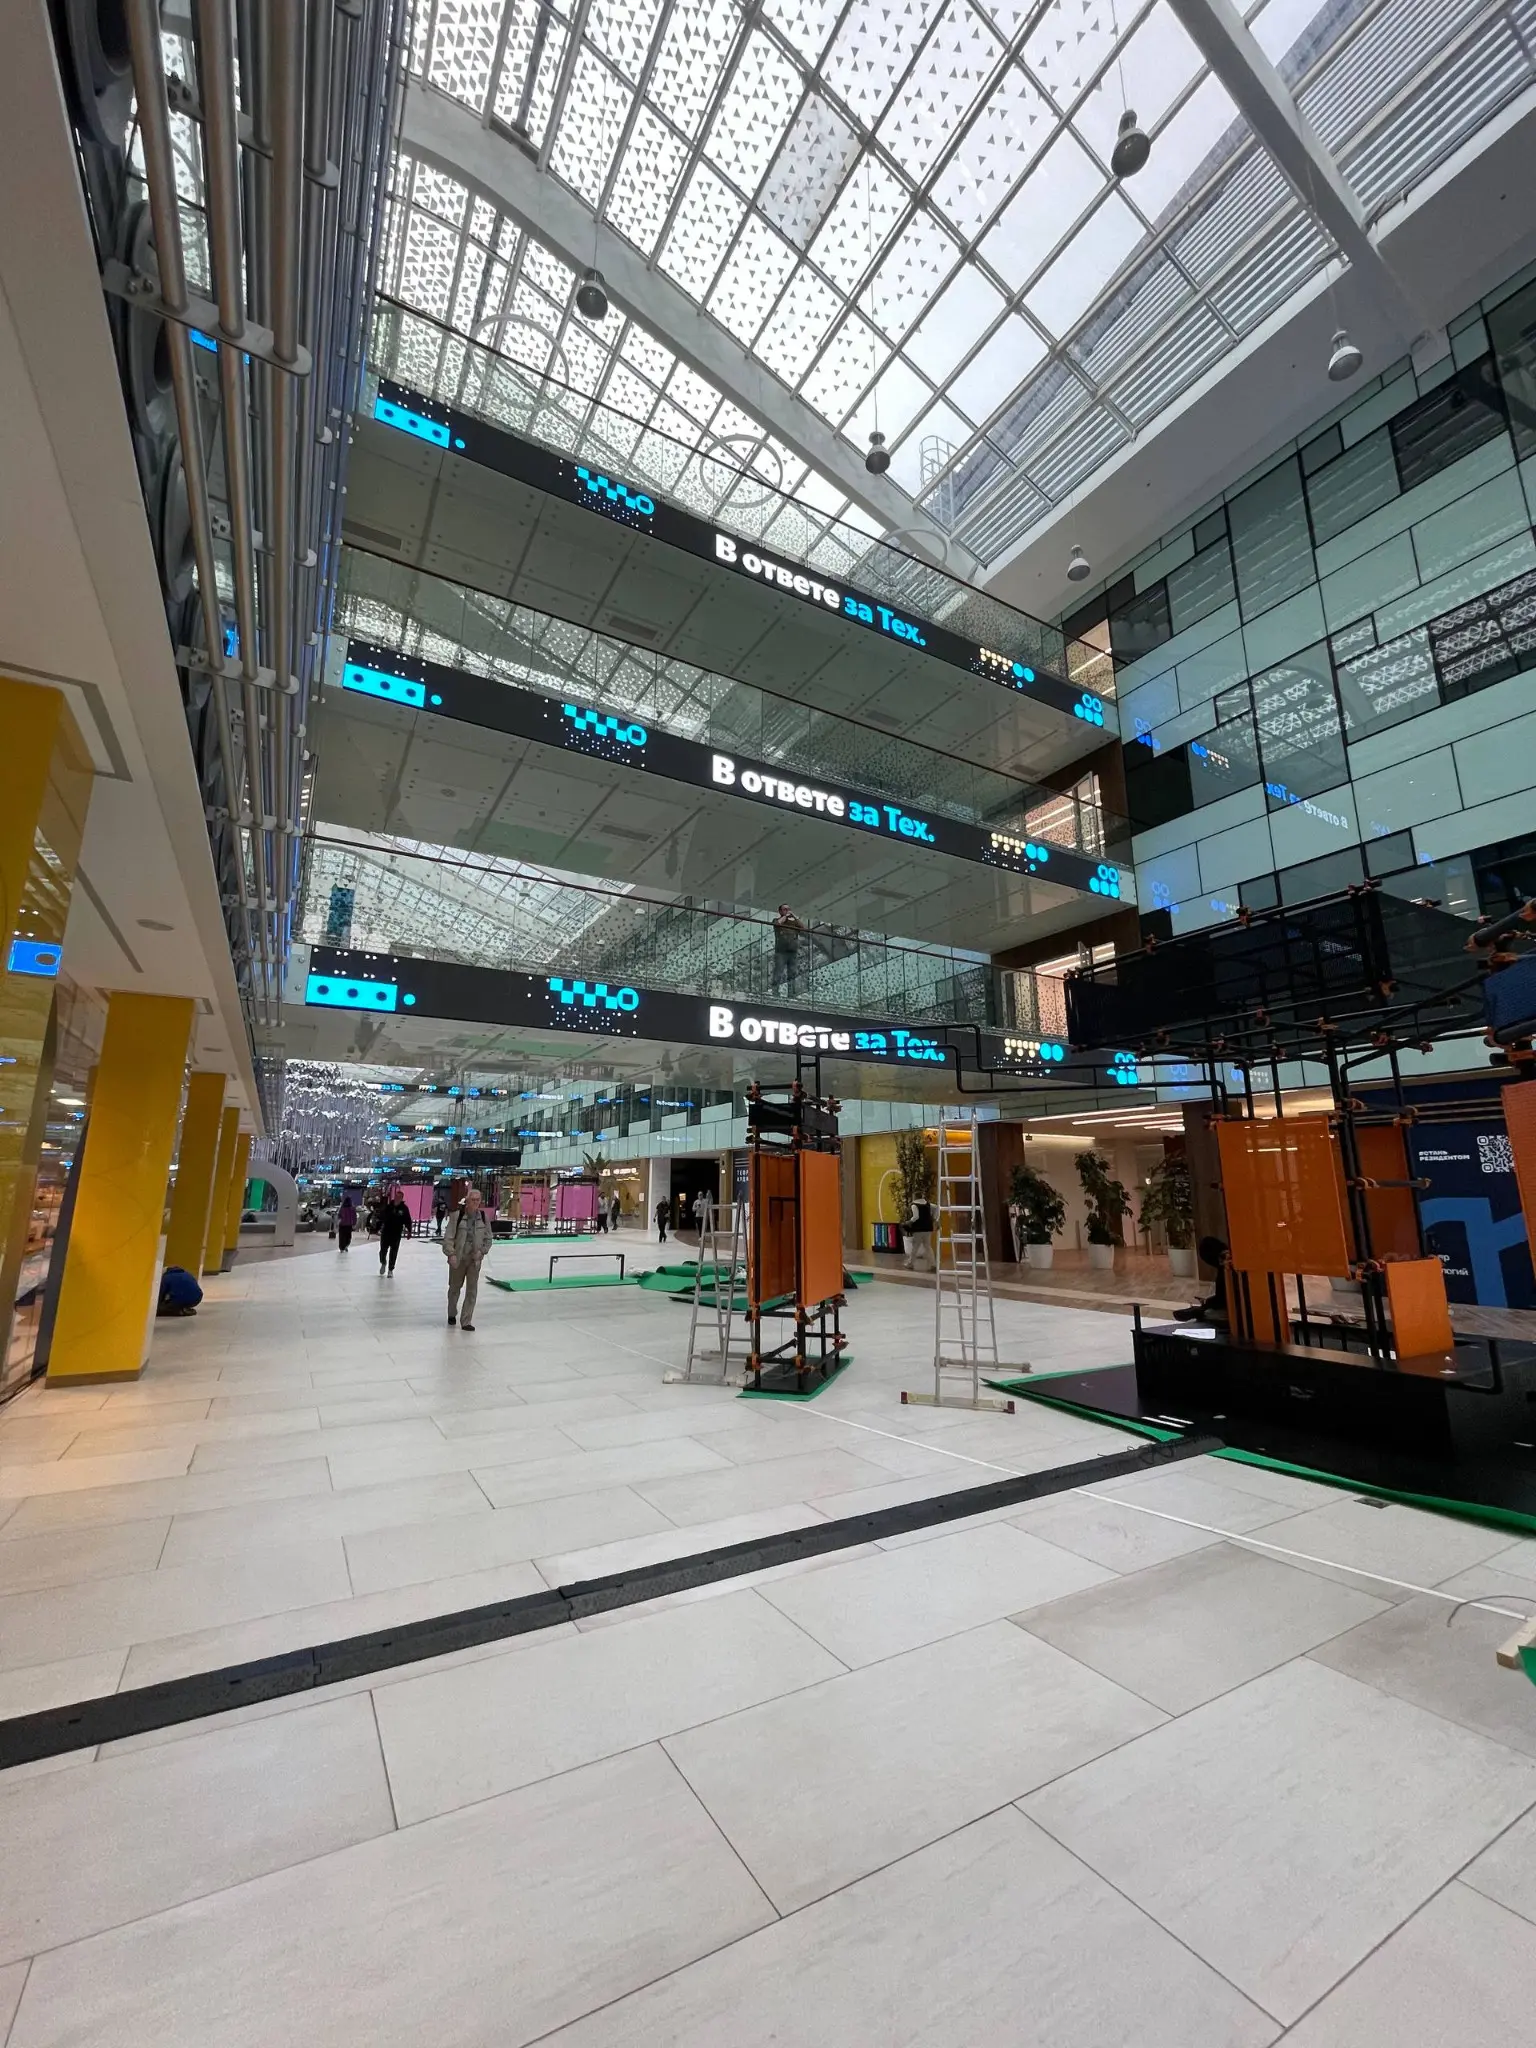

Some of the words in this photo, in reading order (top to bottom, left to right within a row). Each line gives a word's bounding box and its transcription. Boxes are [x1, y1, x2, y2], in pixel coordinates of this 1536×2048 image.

[715, 534, 737, 563] В
[742, 553, 842, 609] ответе
[844, 596, 873, 624] за
[876, 605, 927, 646] Тех.
[712, 754, 736, 785] В
[741, 770, 845, 817] ответе
[849, 801, 880, 827] за
[883, 805, 936, 842] Тех.
[709, 1005, 735, 1038] В
[740, 1017, 850, 1051] ответе
[855, 1032, 888, 1055] за
[890, 1030, 946, 1062] Тех.
